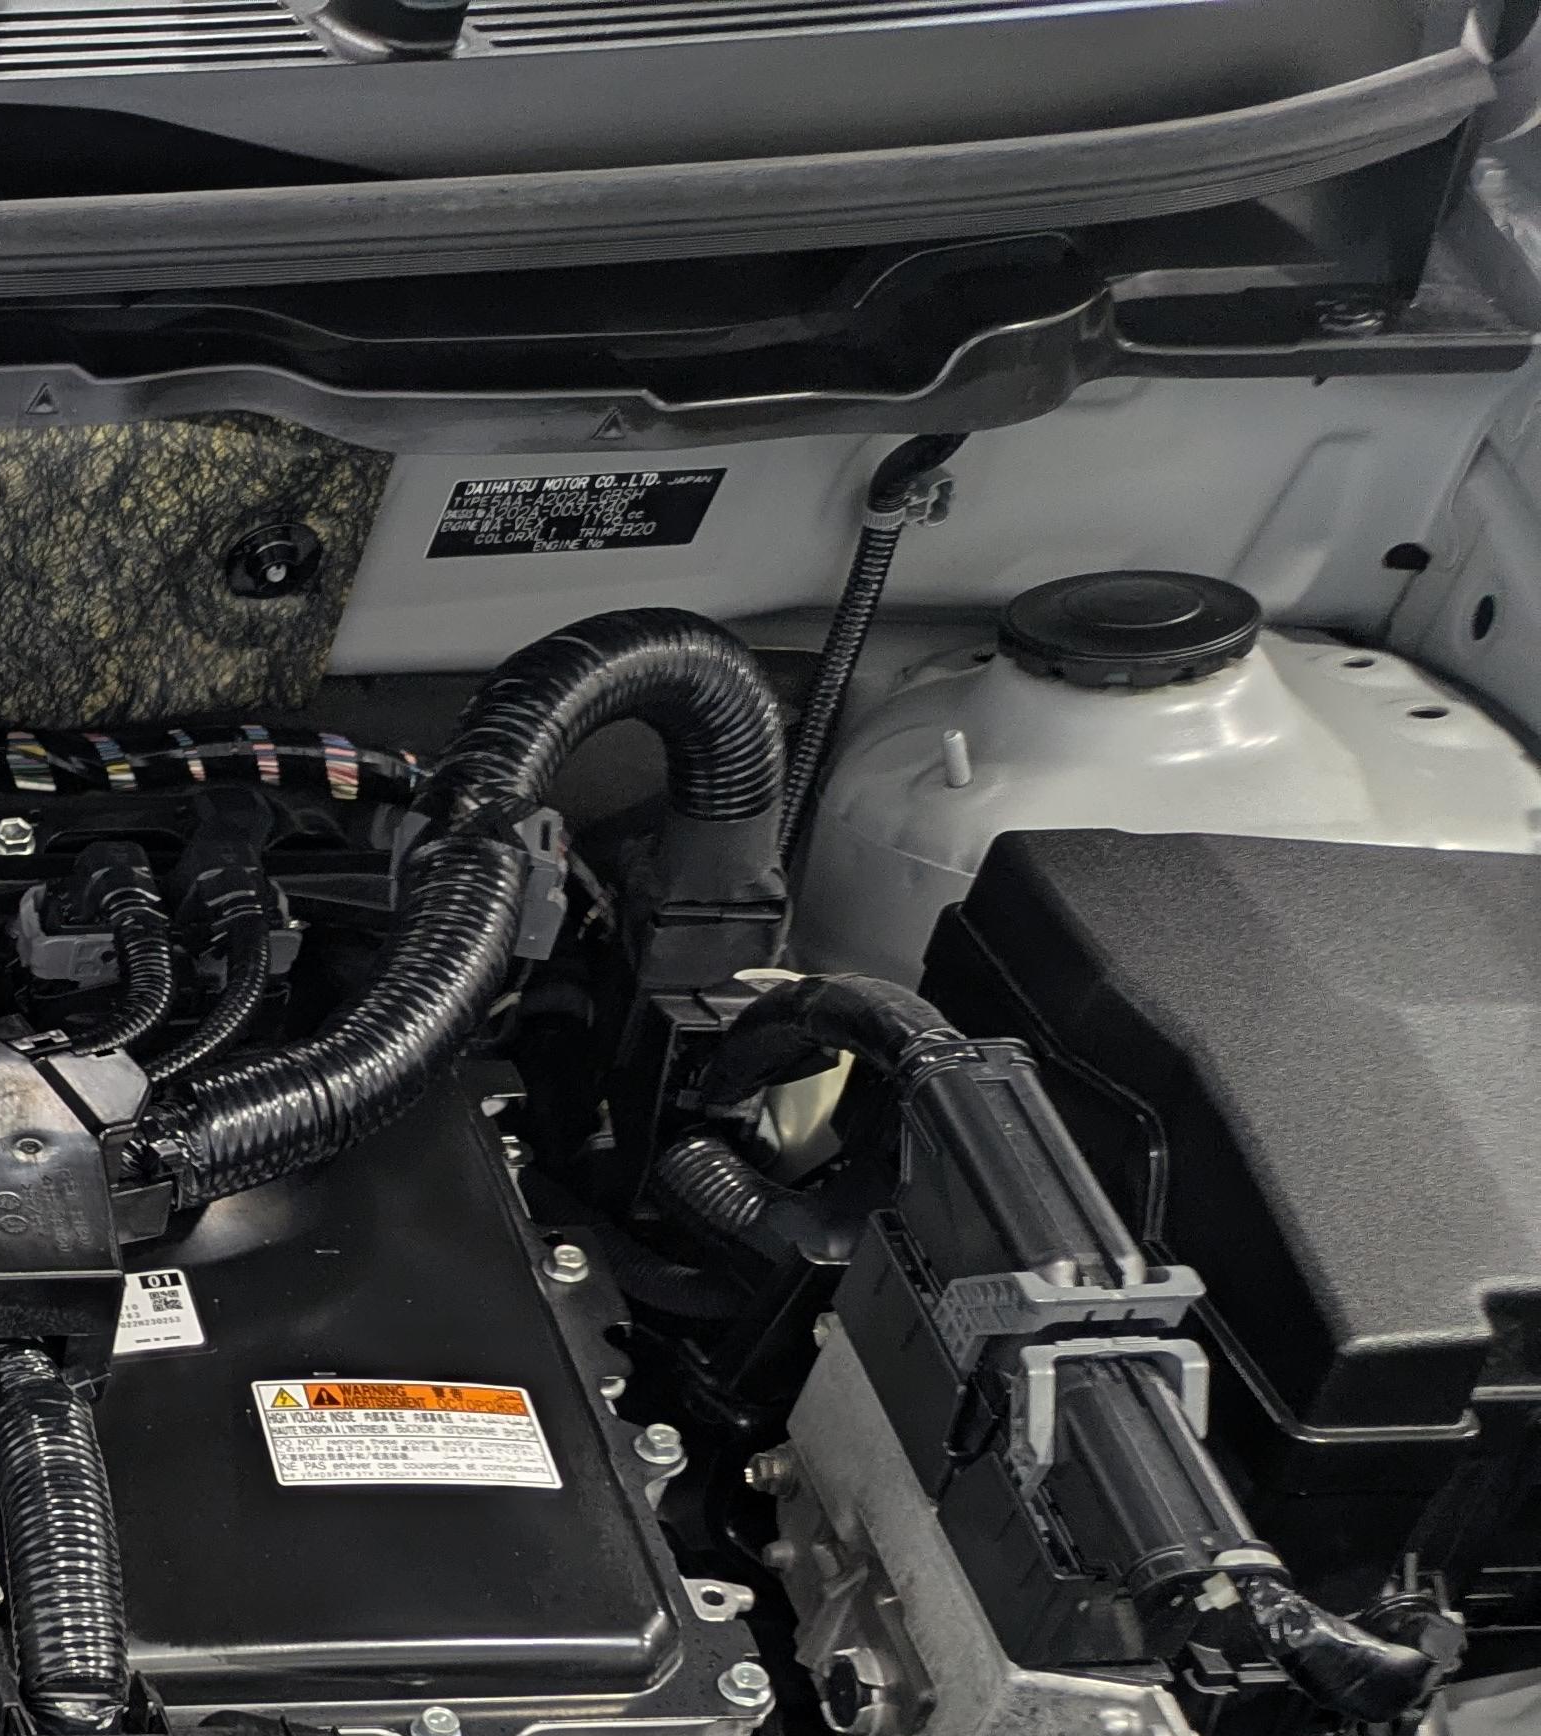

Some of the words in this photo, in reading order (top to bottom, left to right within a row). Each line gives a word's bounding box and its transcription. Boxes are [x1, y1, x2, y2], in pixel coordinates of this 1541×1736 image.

[464, 478, 538, 496] DAIHATSU
[542, 476, 588, 493] MOTOR
[452, 494, 490, 508] TYPE
[532, 540, 581, 553] ENGINE
[147, 1274, 172, 1288] 01
[338, 1385, 407, 1396] WARNING
[342, 1395, 426, 1408] AVERTISSEMENT
[267, 1411, 288, 1424] HIGH
[290, 1411, 327, 1423] VOLTAGE
[330, 1412, 357, 1423] INSIDE
[272, 1426, 299, 1436] HAUTE
[299, 1426, 333, 1435] TENSION
[297, 1438, 321, 1447] NOT
[303, 1461, 327, 1470] PAS
